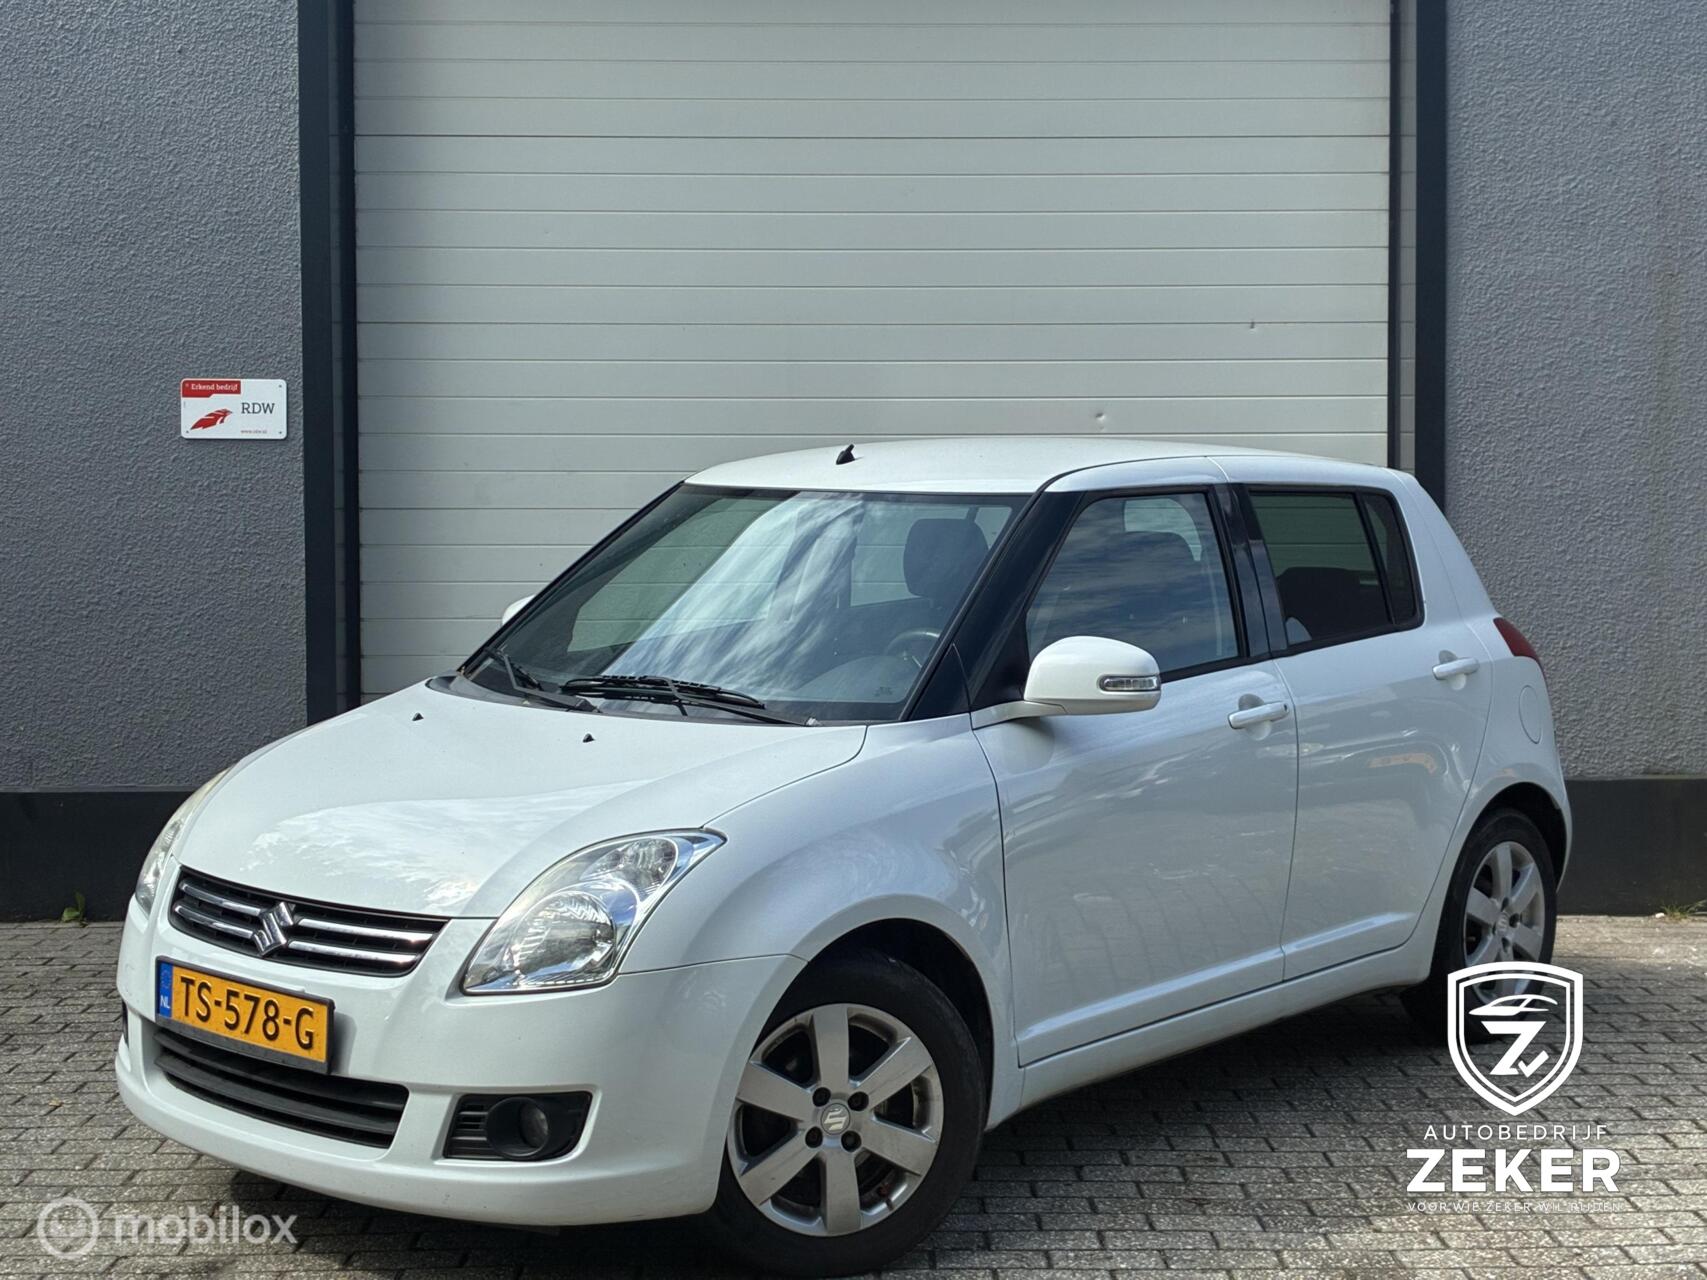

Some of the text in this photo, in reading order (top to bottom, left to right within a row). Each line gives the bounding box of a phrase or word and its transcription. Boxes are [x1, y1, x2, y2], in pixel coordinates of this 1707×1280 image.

[216, 383, 238, 391] bedrijf
[241, 402, 275, 414] RDW
[160, 995, 170, 1009] NL
[180, 976, 315, 1050] TS-578-G
